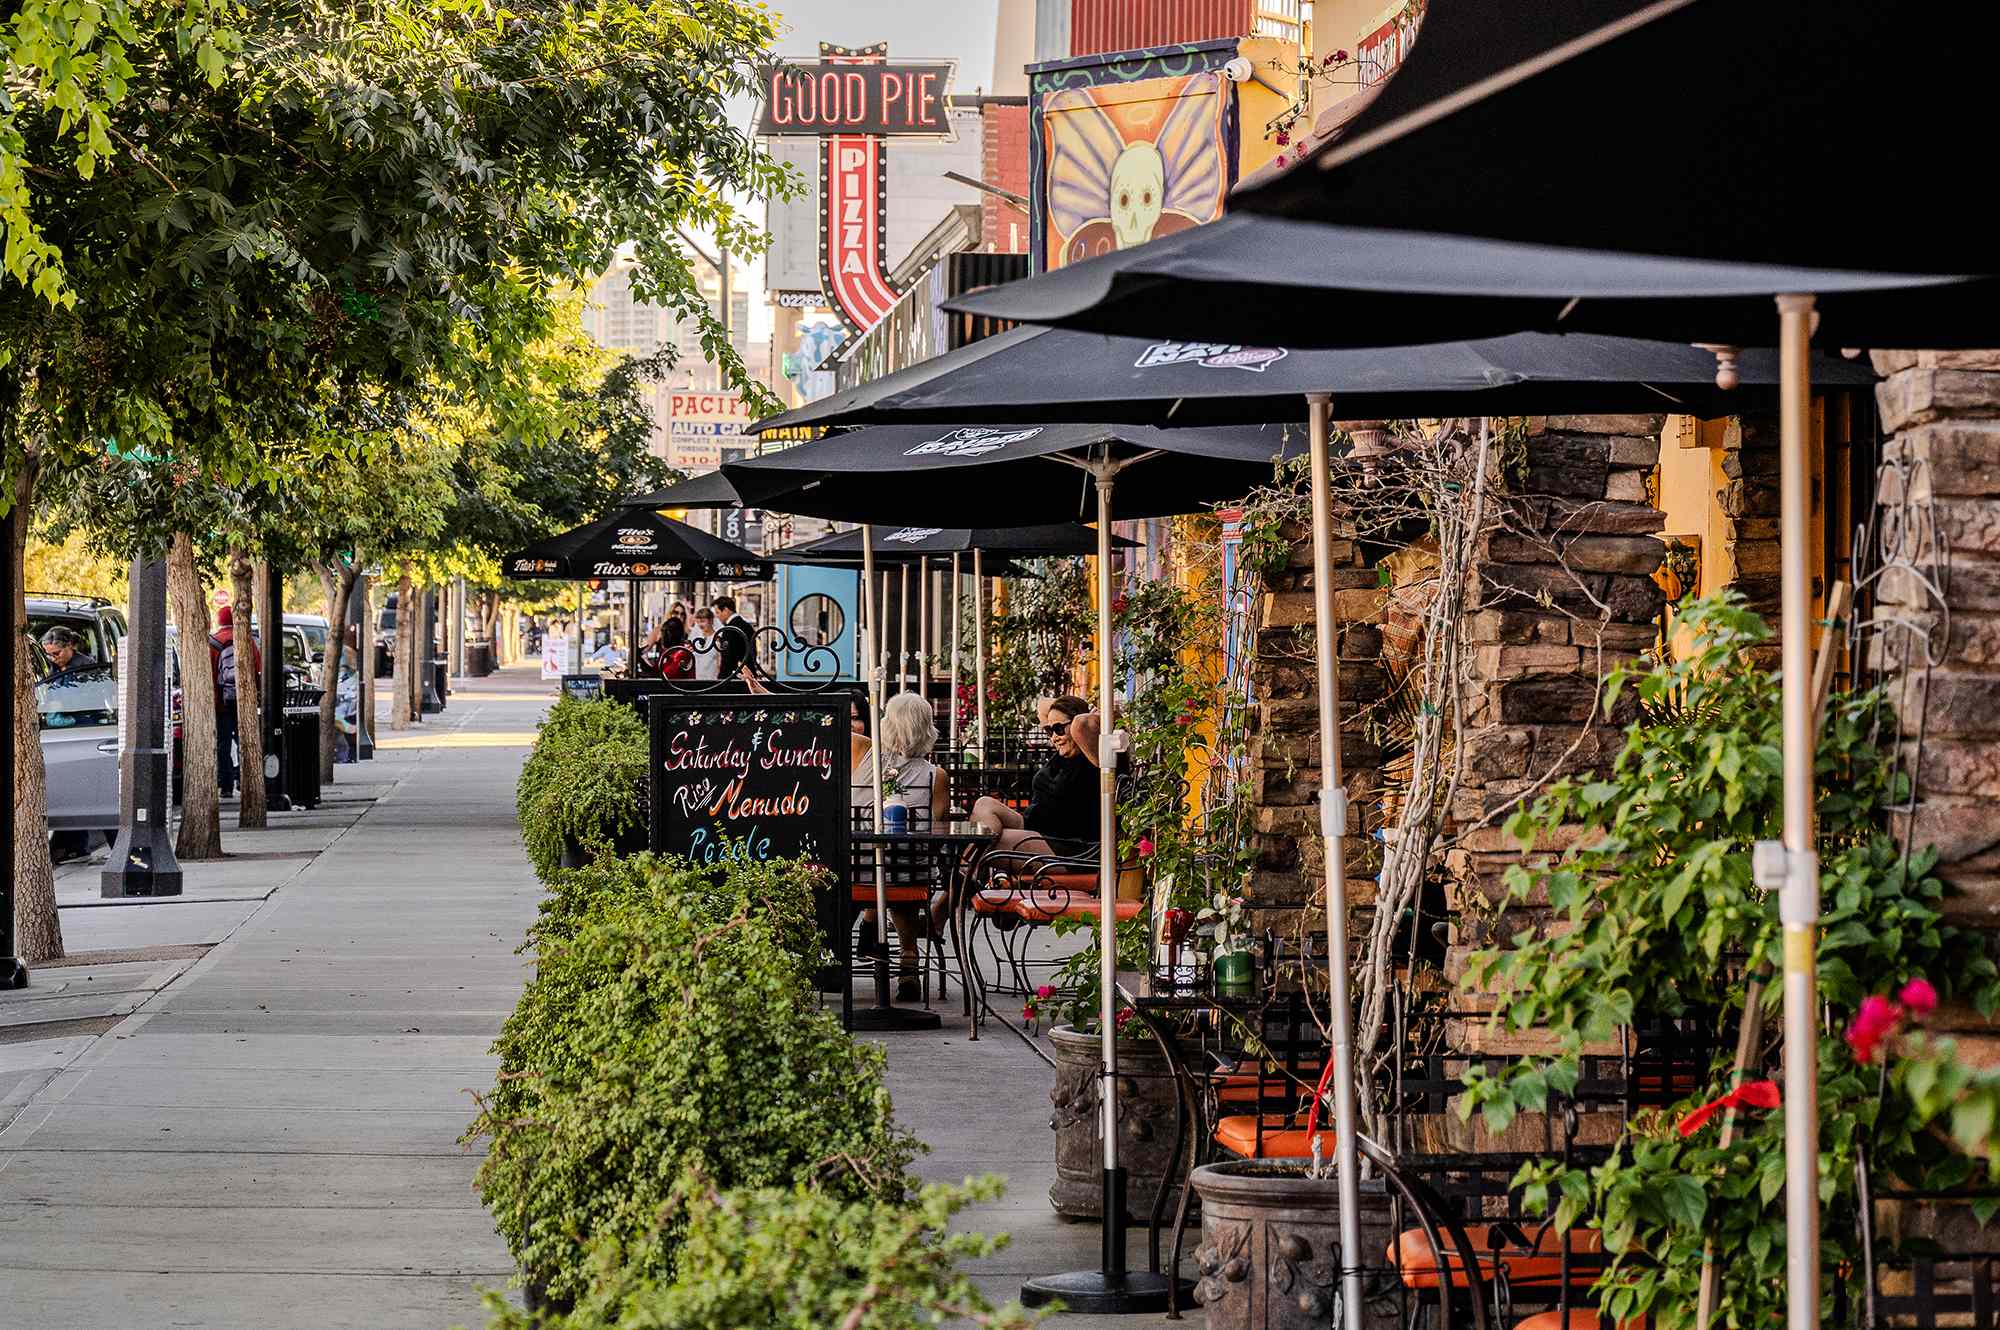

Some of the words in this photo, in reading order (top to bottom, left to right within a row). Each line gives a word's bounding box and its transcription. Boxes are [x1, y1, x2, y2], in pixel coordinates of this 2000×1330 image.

[772, 72, 866, 126] GOOD
[880, 73, 937, 126] PIE
[840, 148, 866, 274] PIZZA
[672, 395, 750, 417] PACIFI
[672, 422, 715, 436] AUTO
[719, 422, 747, 436] CA
[761, 426, 813, 441] MAIN
[593, 562, 630, 576] Tito's
[664, 731, 751, 779] Saturday
[760, 729, 833, 780] Sunday
[673, 777, 712, 818] Rico
[708, 778, 811, 820] Menudo
